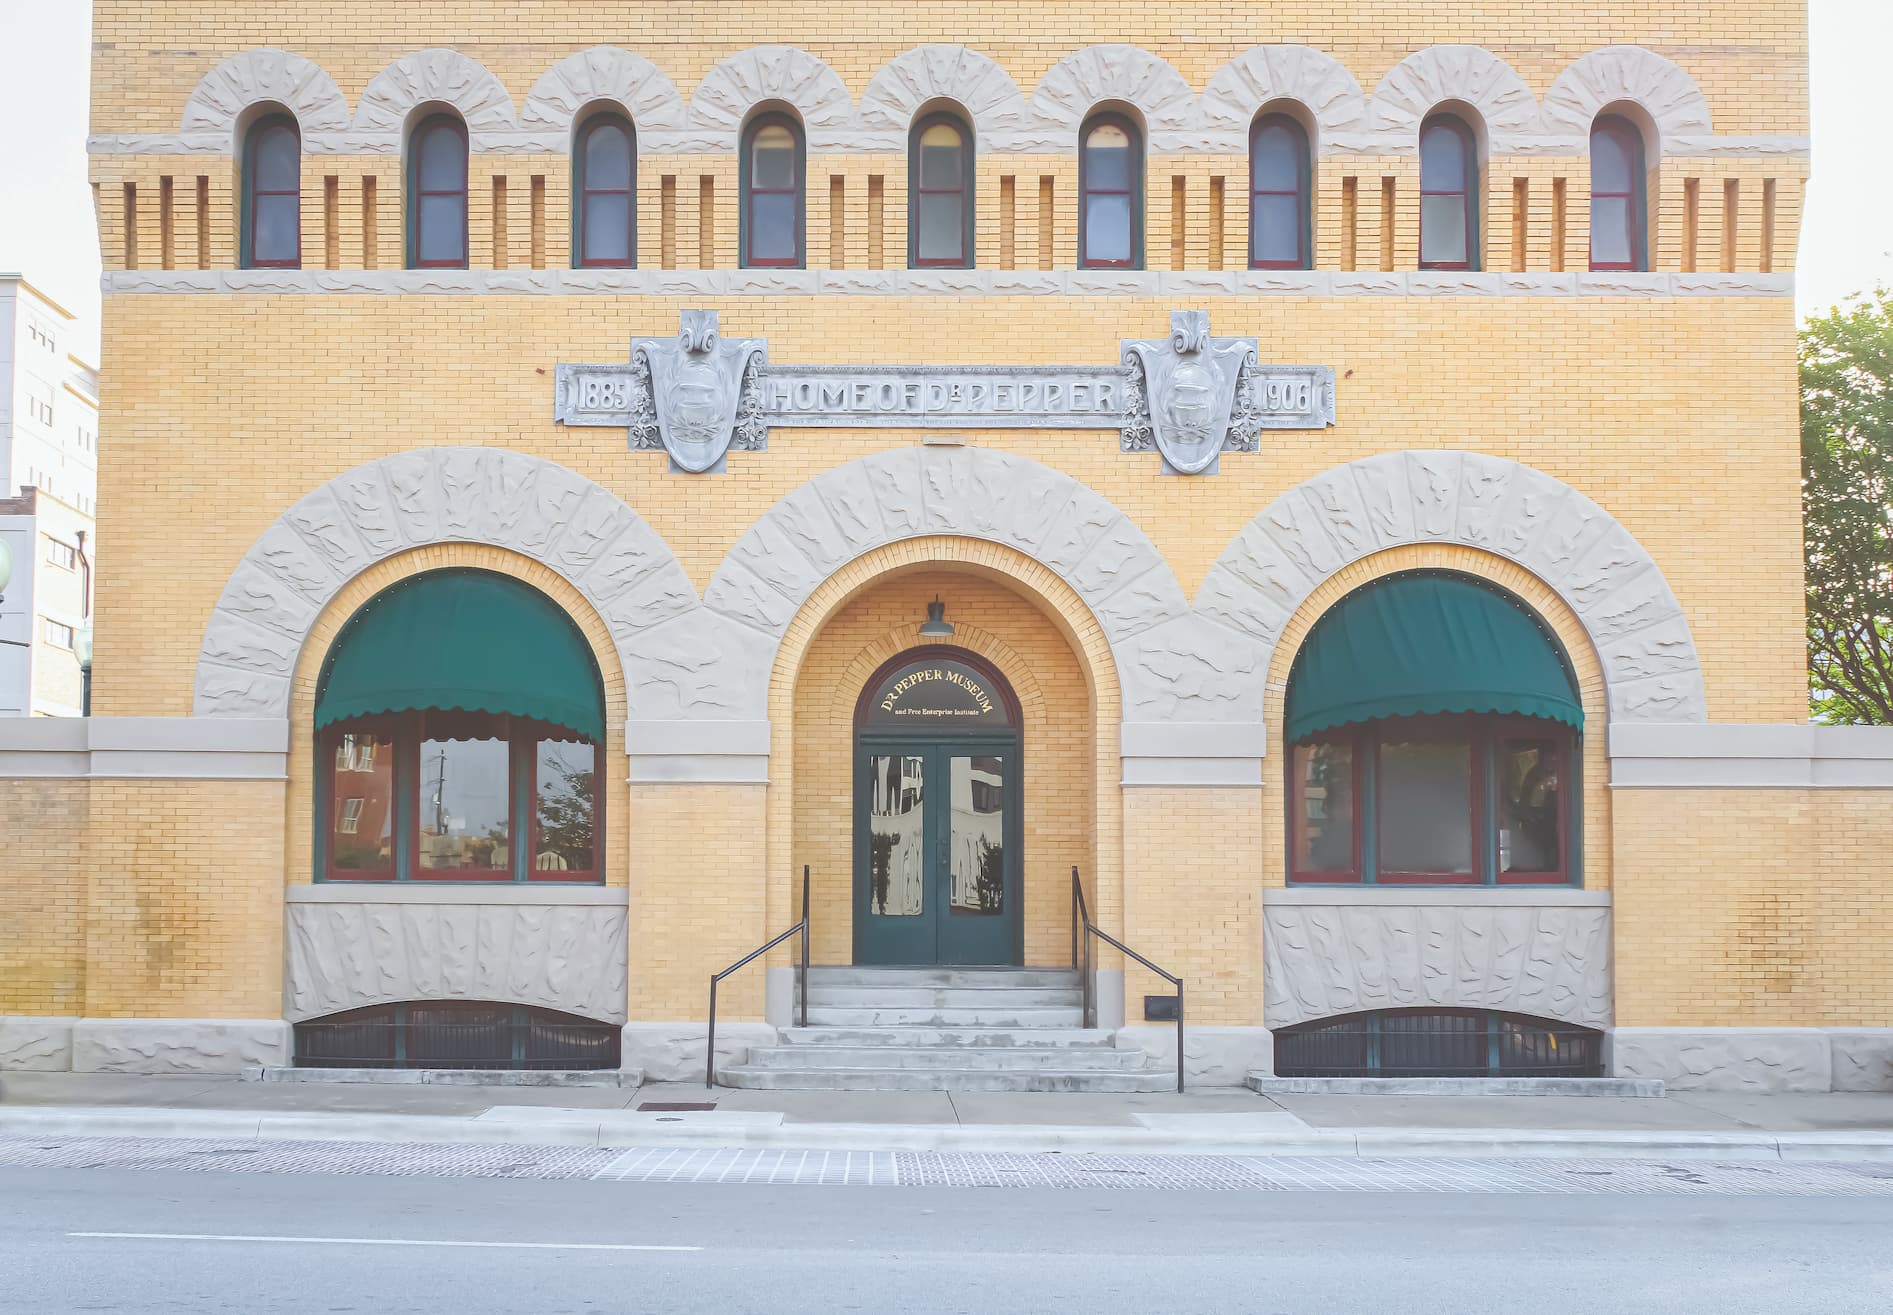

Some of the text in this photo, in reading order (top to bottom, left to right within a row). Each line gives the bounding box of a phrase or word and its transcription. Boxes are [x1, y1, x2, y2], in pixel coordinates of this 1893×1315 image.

[578, 380, 629, 411] 1885
[770, 381, 873, 412] HOME
[877, 381, 922, 412] OF
[967, 381, 1118, 412] PEPPER
[1262, 380, 1312, 411] 1906
[880, 669, 993, 714] DR PEPPER MUSEUM
[922, 708, 953, 717] Enterprise
[954, 708, 980, 716] Institute
